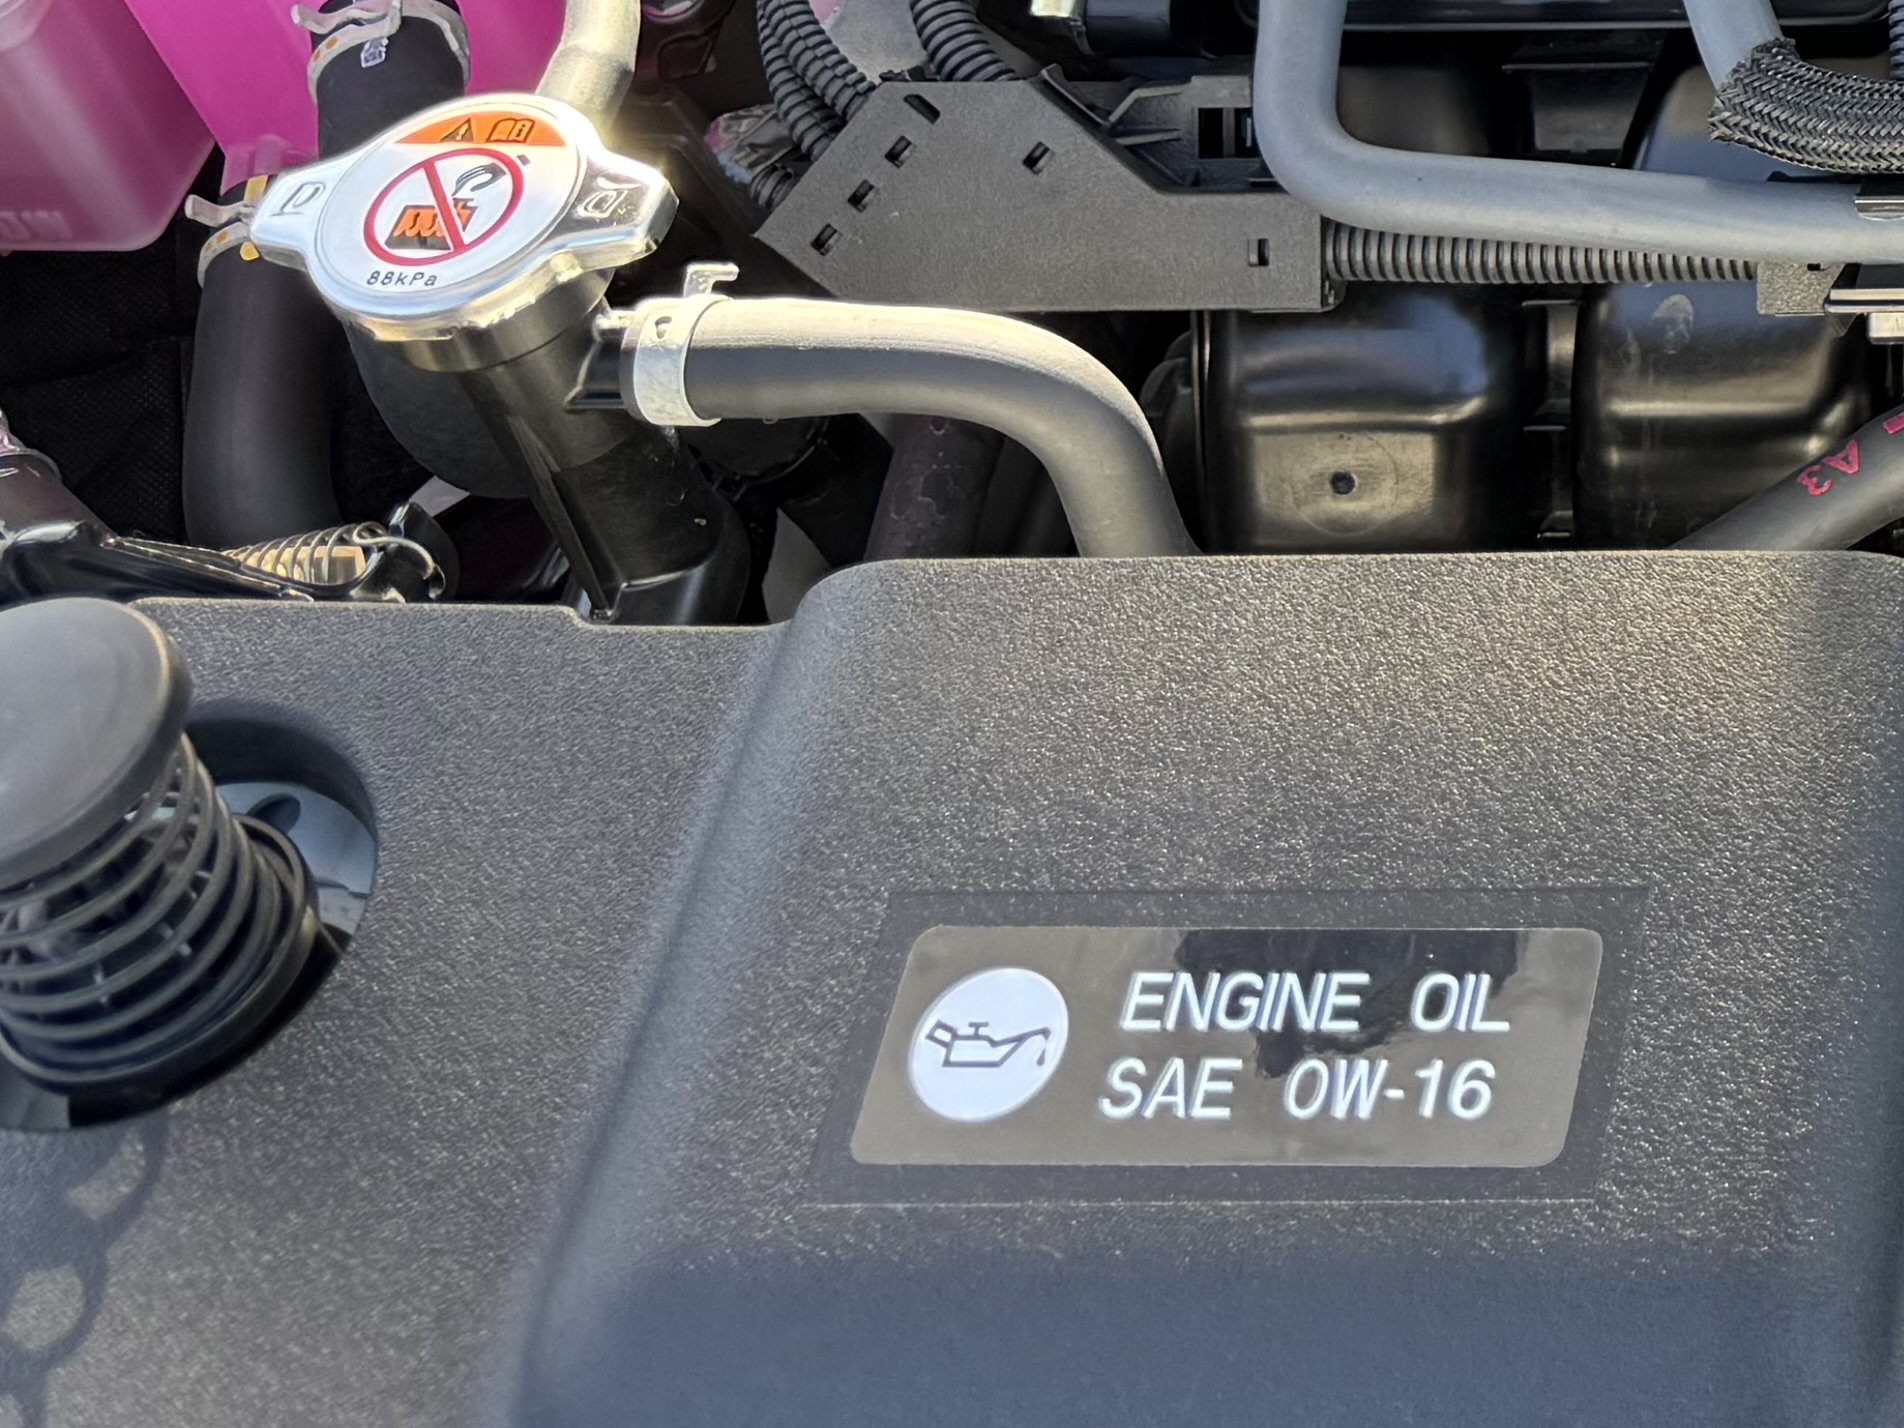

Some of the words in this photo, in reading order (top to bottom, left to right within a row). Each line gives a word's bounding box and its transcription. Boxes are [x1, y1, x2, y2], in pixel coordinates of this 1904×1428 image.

[366, 269, 438, 288] 88kPa
[1795, 438, 1861, 497] A3
[1118, 971, 1371, 1032] ENGINE
[1409, 971, 1512, 1033] OIL
[1097, 1056, 1243, 1121] SAE
[1284, 1057, 1497, 1121] 0W-16
